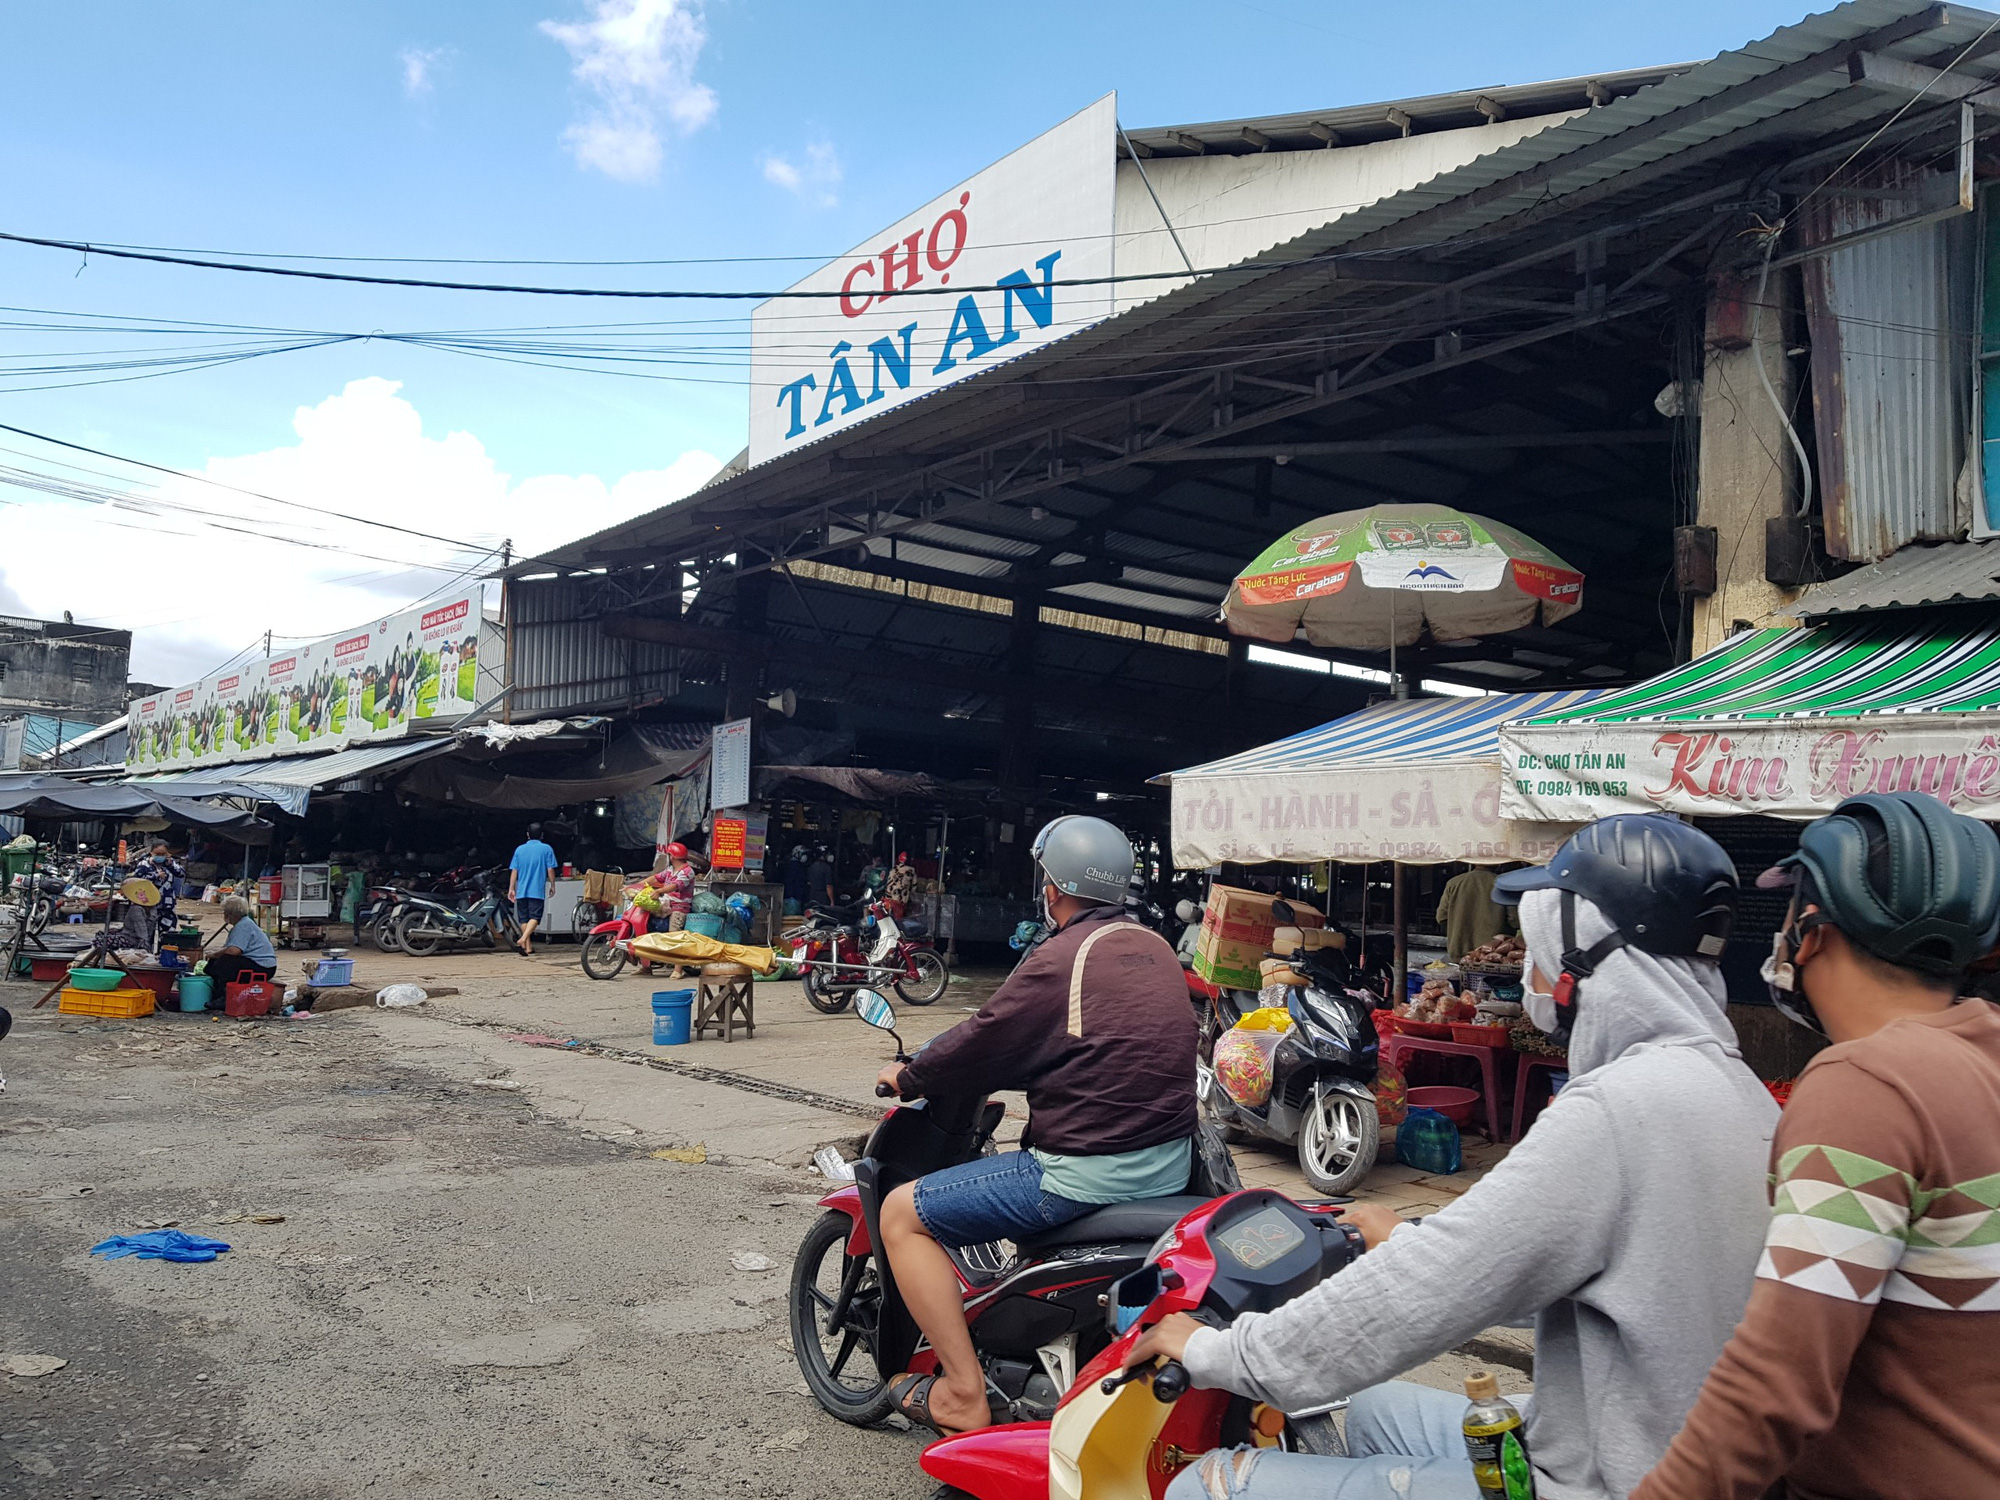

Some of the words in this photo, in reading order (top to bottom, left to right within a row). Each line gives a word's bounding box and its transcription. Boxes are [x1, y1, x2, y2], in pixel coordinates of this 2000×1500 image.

[840, 191, 970, 319] CHỢ
[776, 321, 918, 440] TÂN
[932, 249, 1062, 376] AN
[1272, 545, 1340, 568] Carabao
[1244, 577, 1266, 589] Nước
[1268, 575, 1289, 586] Tăng
[1291, 572, 1307, 584] Lực
[1296, 572, 1345, 597] Carabao
[1550, 582, 1580, 596] Carabao
[1518, 754, 1542, 770] ĐC:
[1544, 753, 1571, 773] CHỢ
[1574, 750, 1601, 770] TÂN
[1606, 753, 1626, 770] AN
[1644, 731, 1794, 801] Kim
[1537, 780, 1572, 796] 0984
[1576, 780, 1600, 796] 169
[1602, 780, 1628, 796] 953
[1182, 789, 1235, 832] TỎI
[1259, 789, 1361, 831] HÀNH
[1390, 780, 1441, 828] SẢ
[1246, 842, 1260, 858] &
[1334, 842, 1370, 858] ĐT:
[1461, 842, 1510, 858] 169
[1521, 841, 1564, 858] 95
[1086, 866, 1114, 882] Chubb
[1114, 874, 1126, 884] Life
